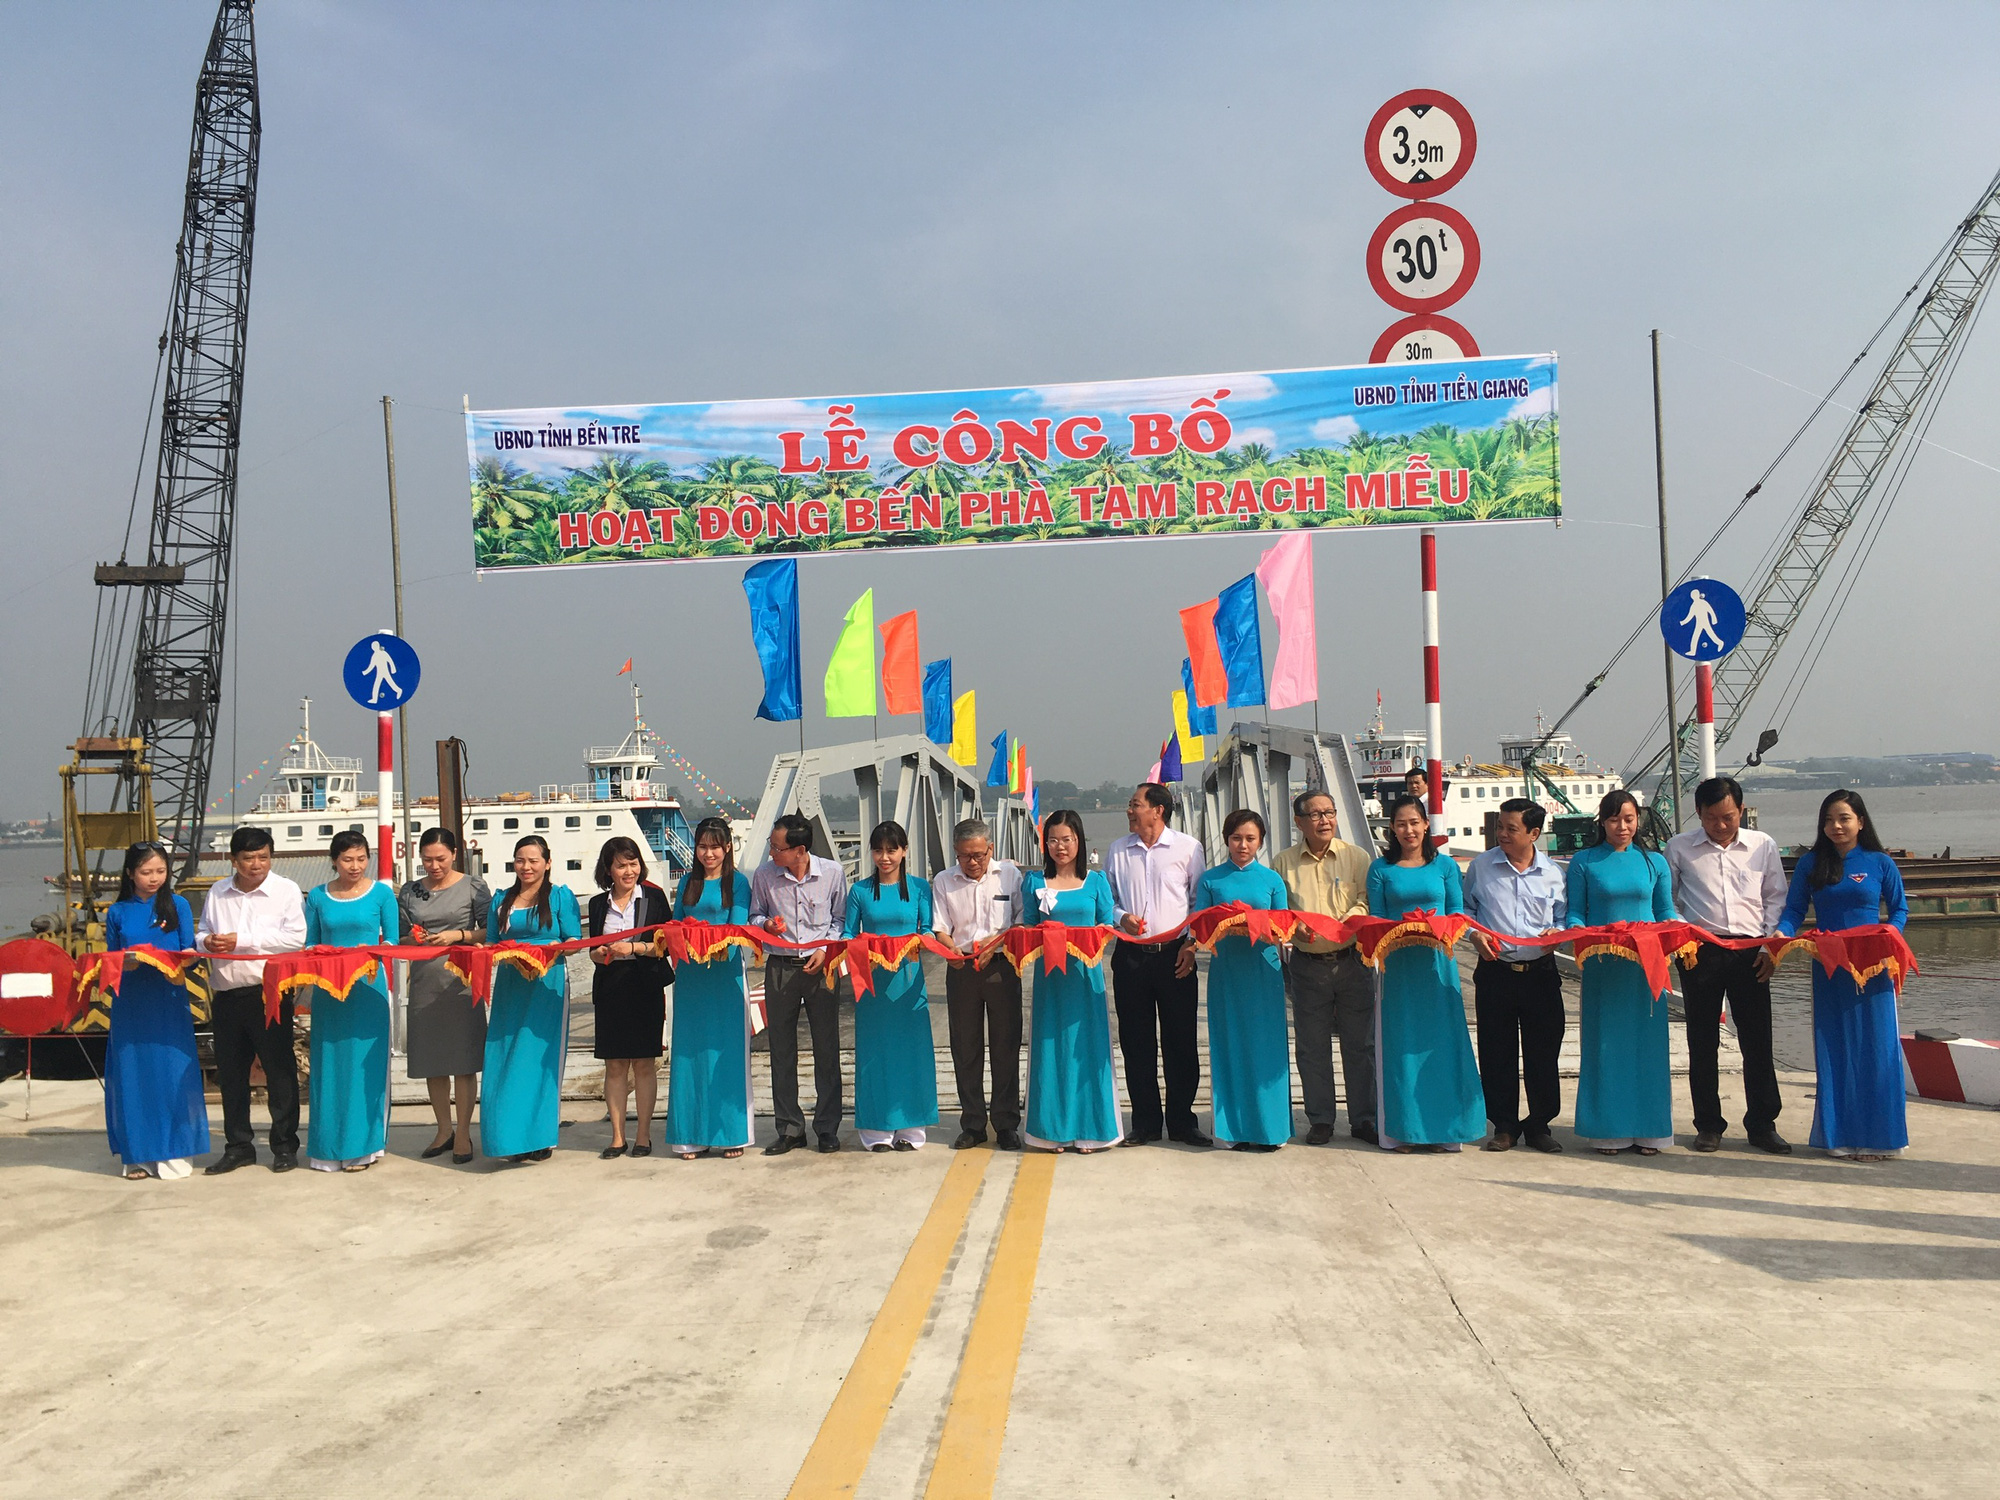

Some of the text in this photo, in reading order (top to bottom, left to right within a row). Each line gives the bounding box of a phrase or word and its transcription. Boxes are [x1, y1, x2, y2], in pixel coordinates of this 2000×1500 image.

[1393, 126, 1444, 167] 3,9m
[1354, 373, 1529, 406] UBND TỈNH TIỀN GIANG
[494, 419, 641, 450] UBND TỈNH BẾN TRE
[778, 388, 1232, 475] LỄ CÔNG BỐ
[558, 453, 1471, 552] HOẠT ĐỘNG BẾN PHÀ TẠM RẠCH MIỄU
